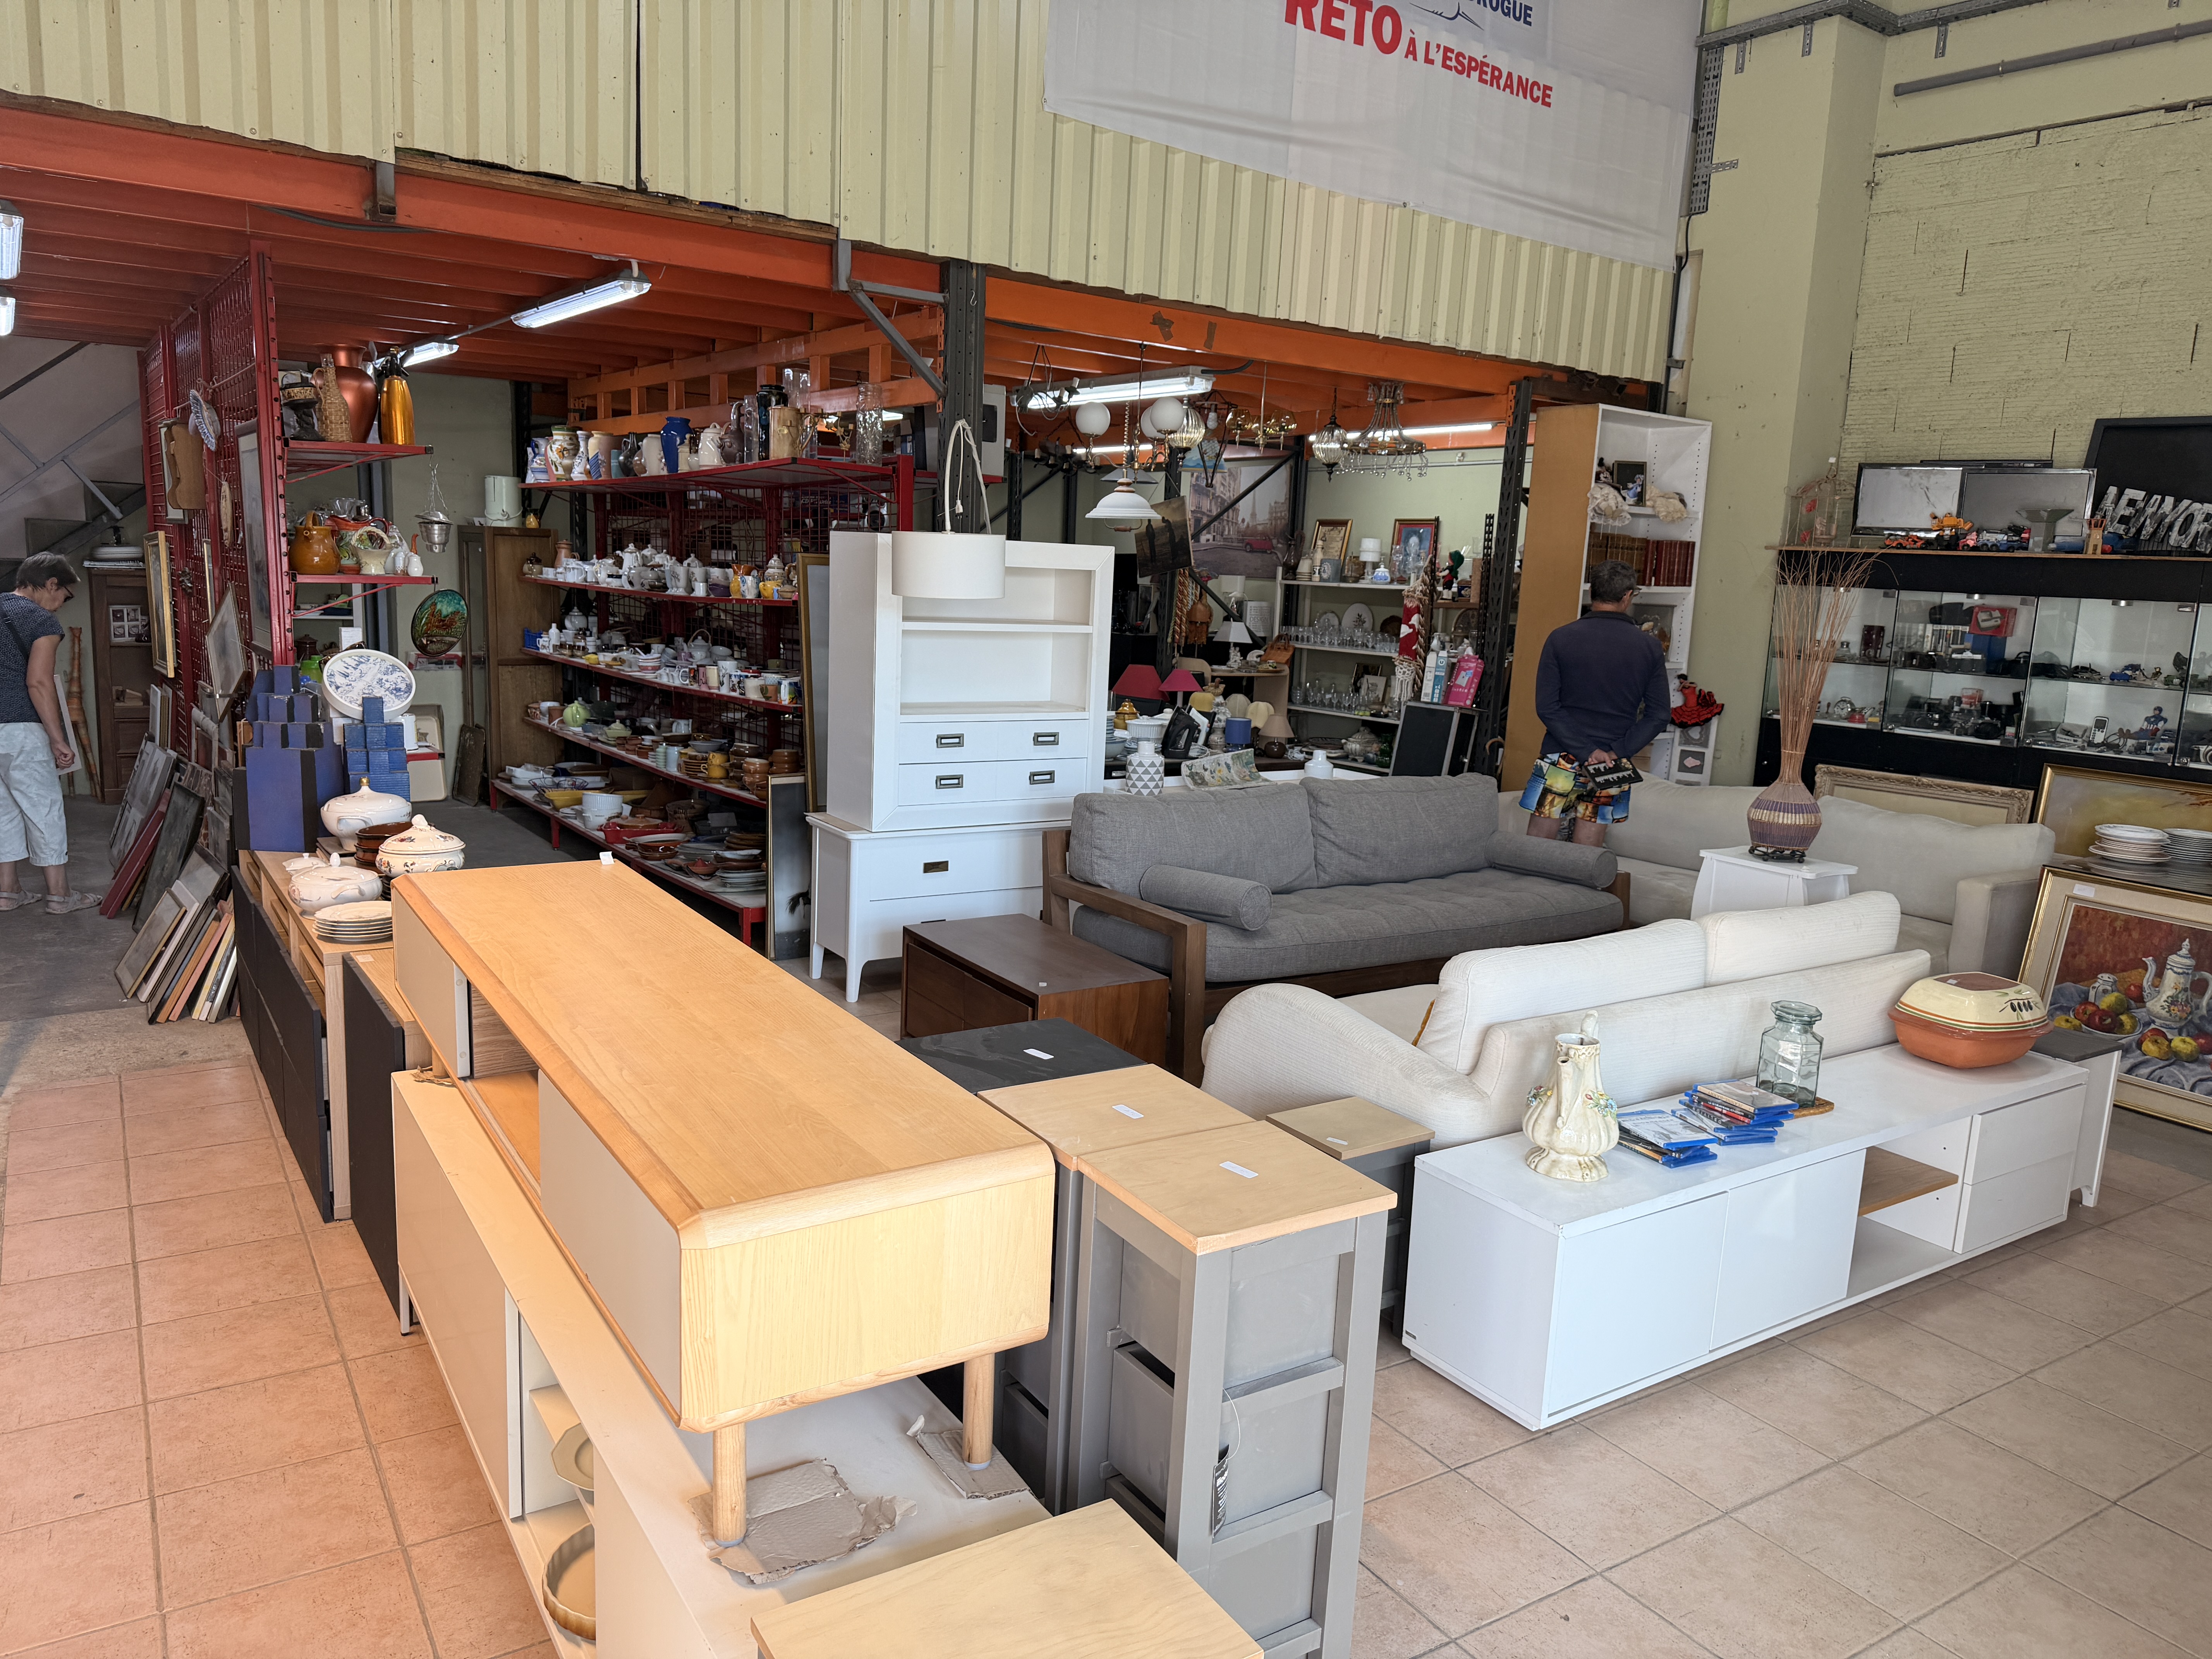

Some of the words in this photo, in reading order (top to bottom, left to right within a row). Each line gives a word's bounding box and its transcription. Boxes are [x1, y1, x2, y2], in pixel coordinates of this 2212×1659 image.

[1469, 0, 1532, 26] OGUE
[1285, 0, 1402, 54] RETO
[1404, 29, 1418, 62] À
[1424, 40, 1553, 108] L'ESPÉRANCE
[1692, 1107, 1722, 1124] OBLIVION
